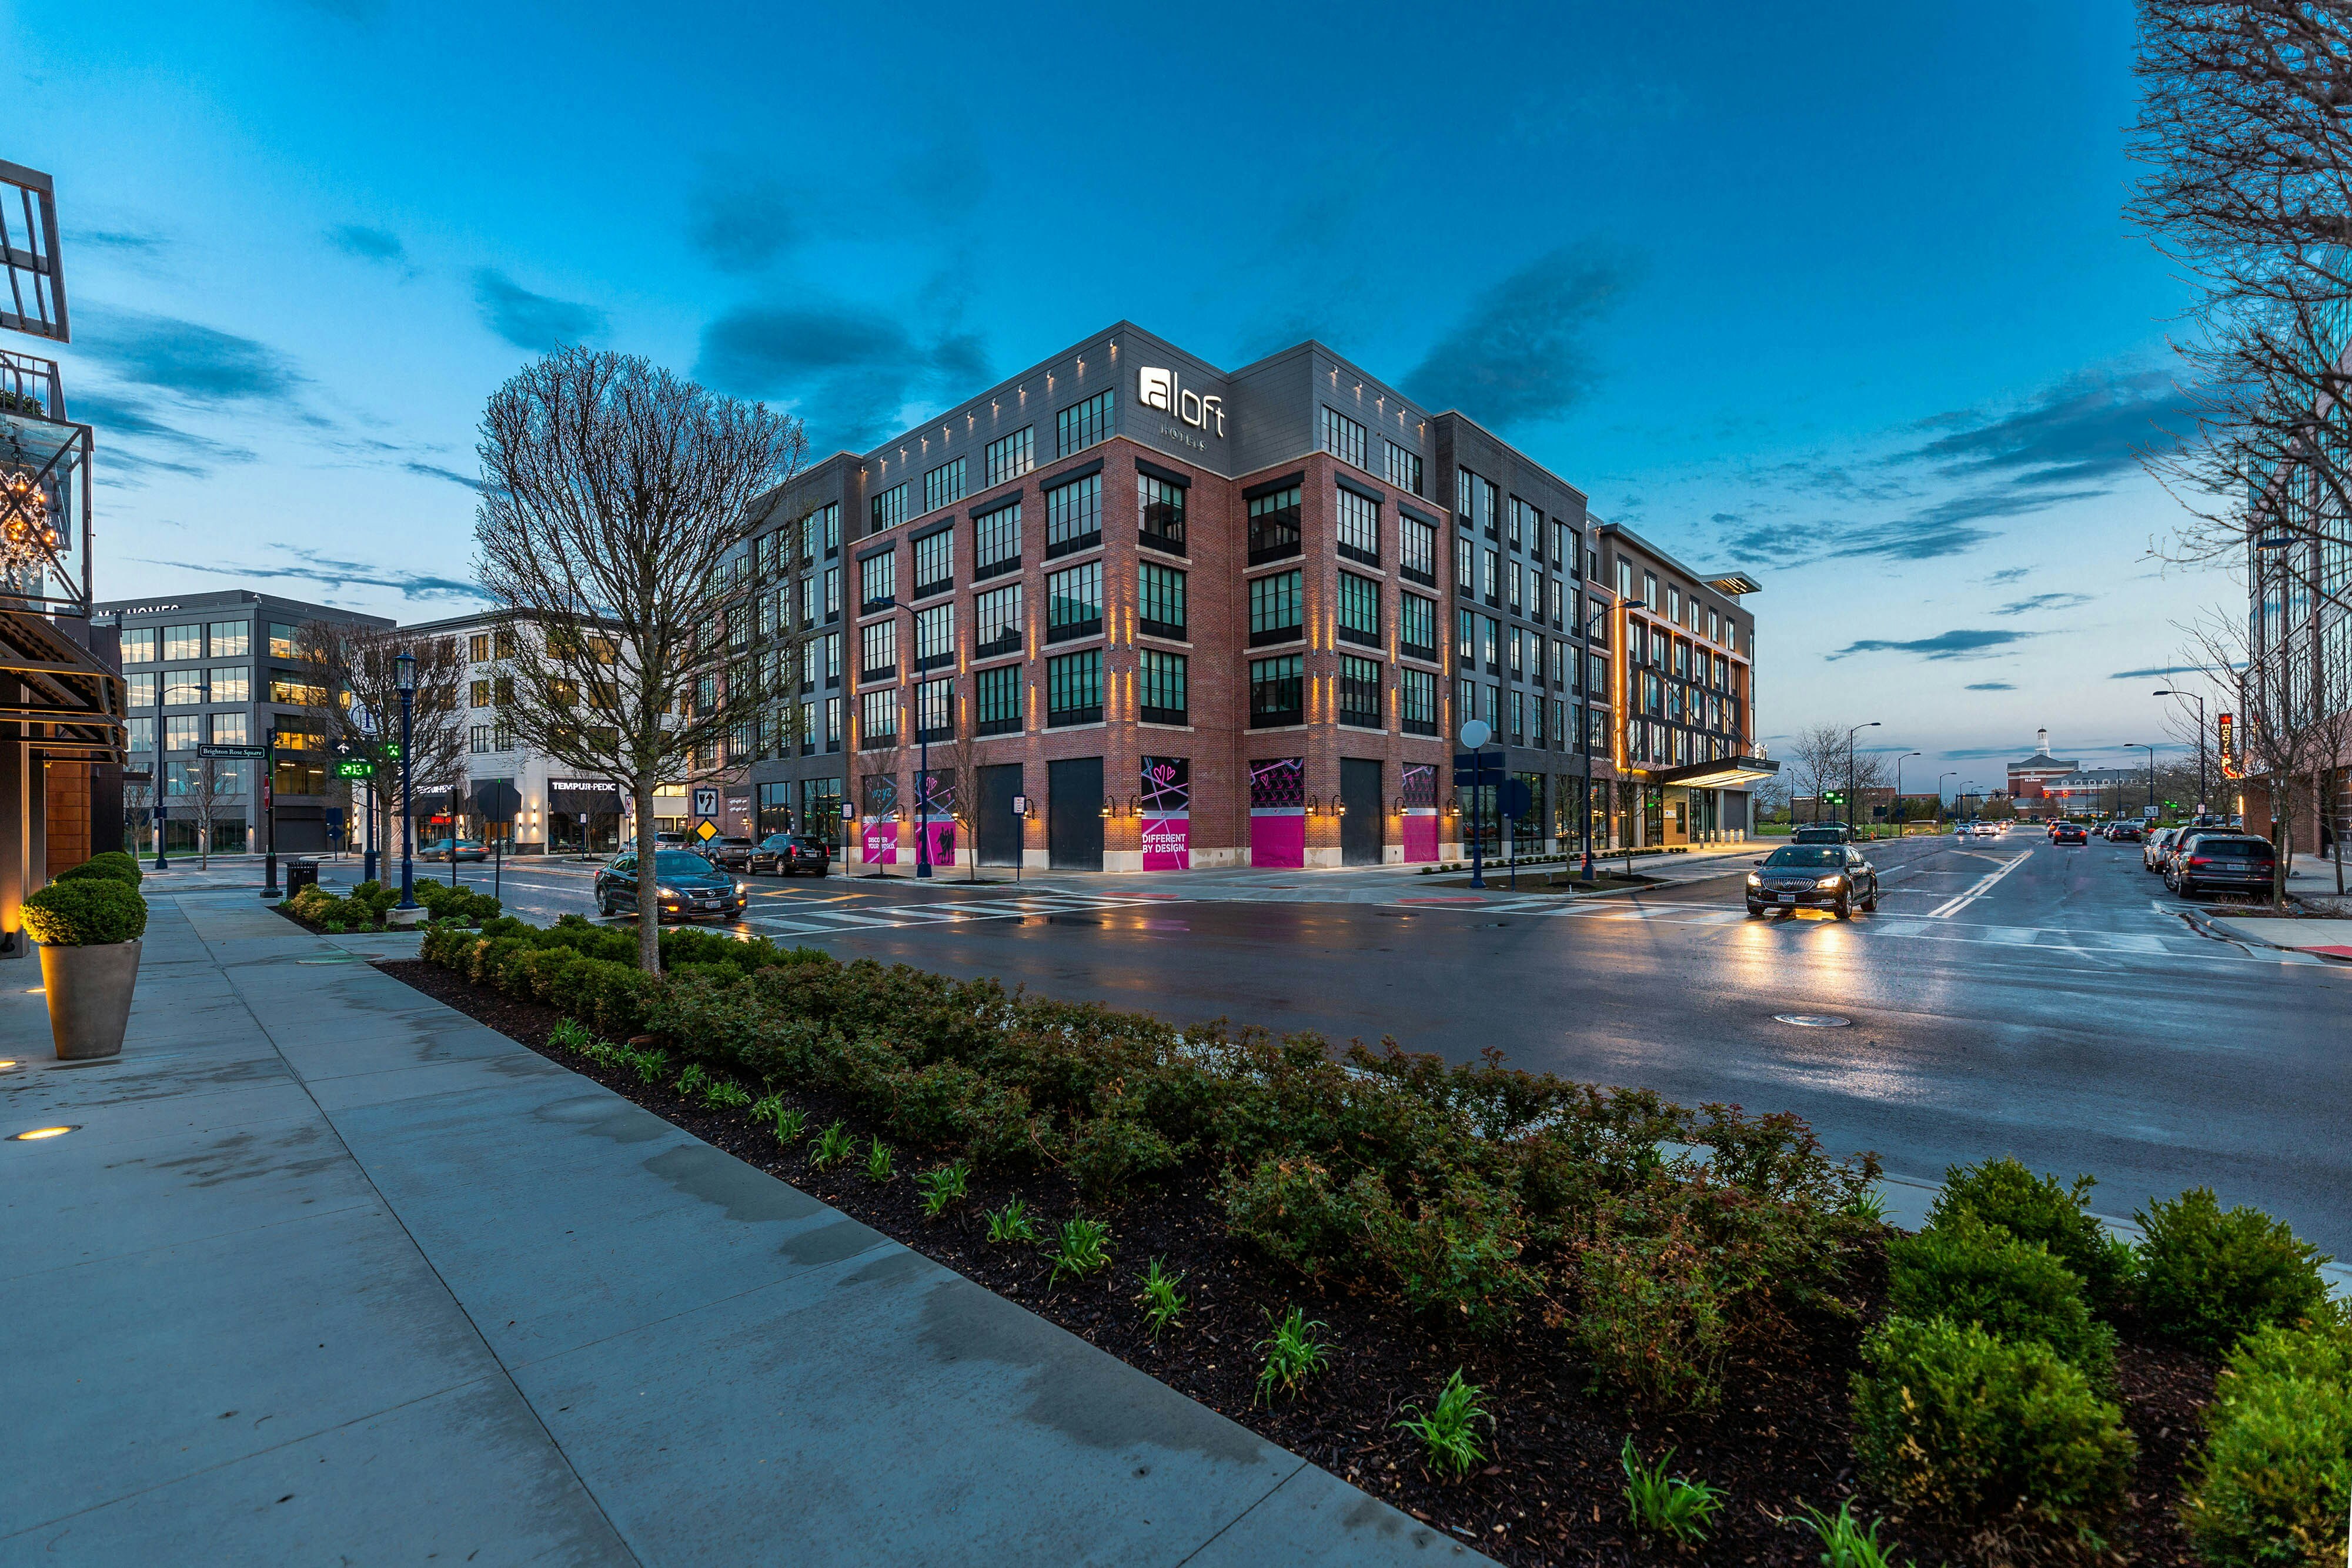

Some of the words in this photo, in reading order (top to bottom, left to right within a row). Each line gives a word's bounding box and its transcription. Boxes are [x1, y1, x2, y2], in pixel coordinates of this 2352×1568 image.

[1139, 366, 1225, 438] aloft
[1161, 423, 1207, 451] HOTELS
[552, 782, 616, 791] TEMPUR-PEDIC
[1142, 834, 1186, 843] DIFFERENT
[1142, 844, 1153, 853] BY
[1155, 843, 1186, 853] DESIGN.
